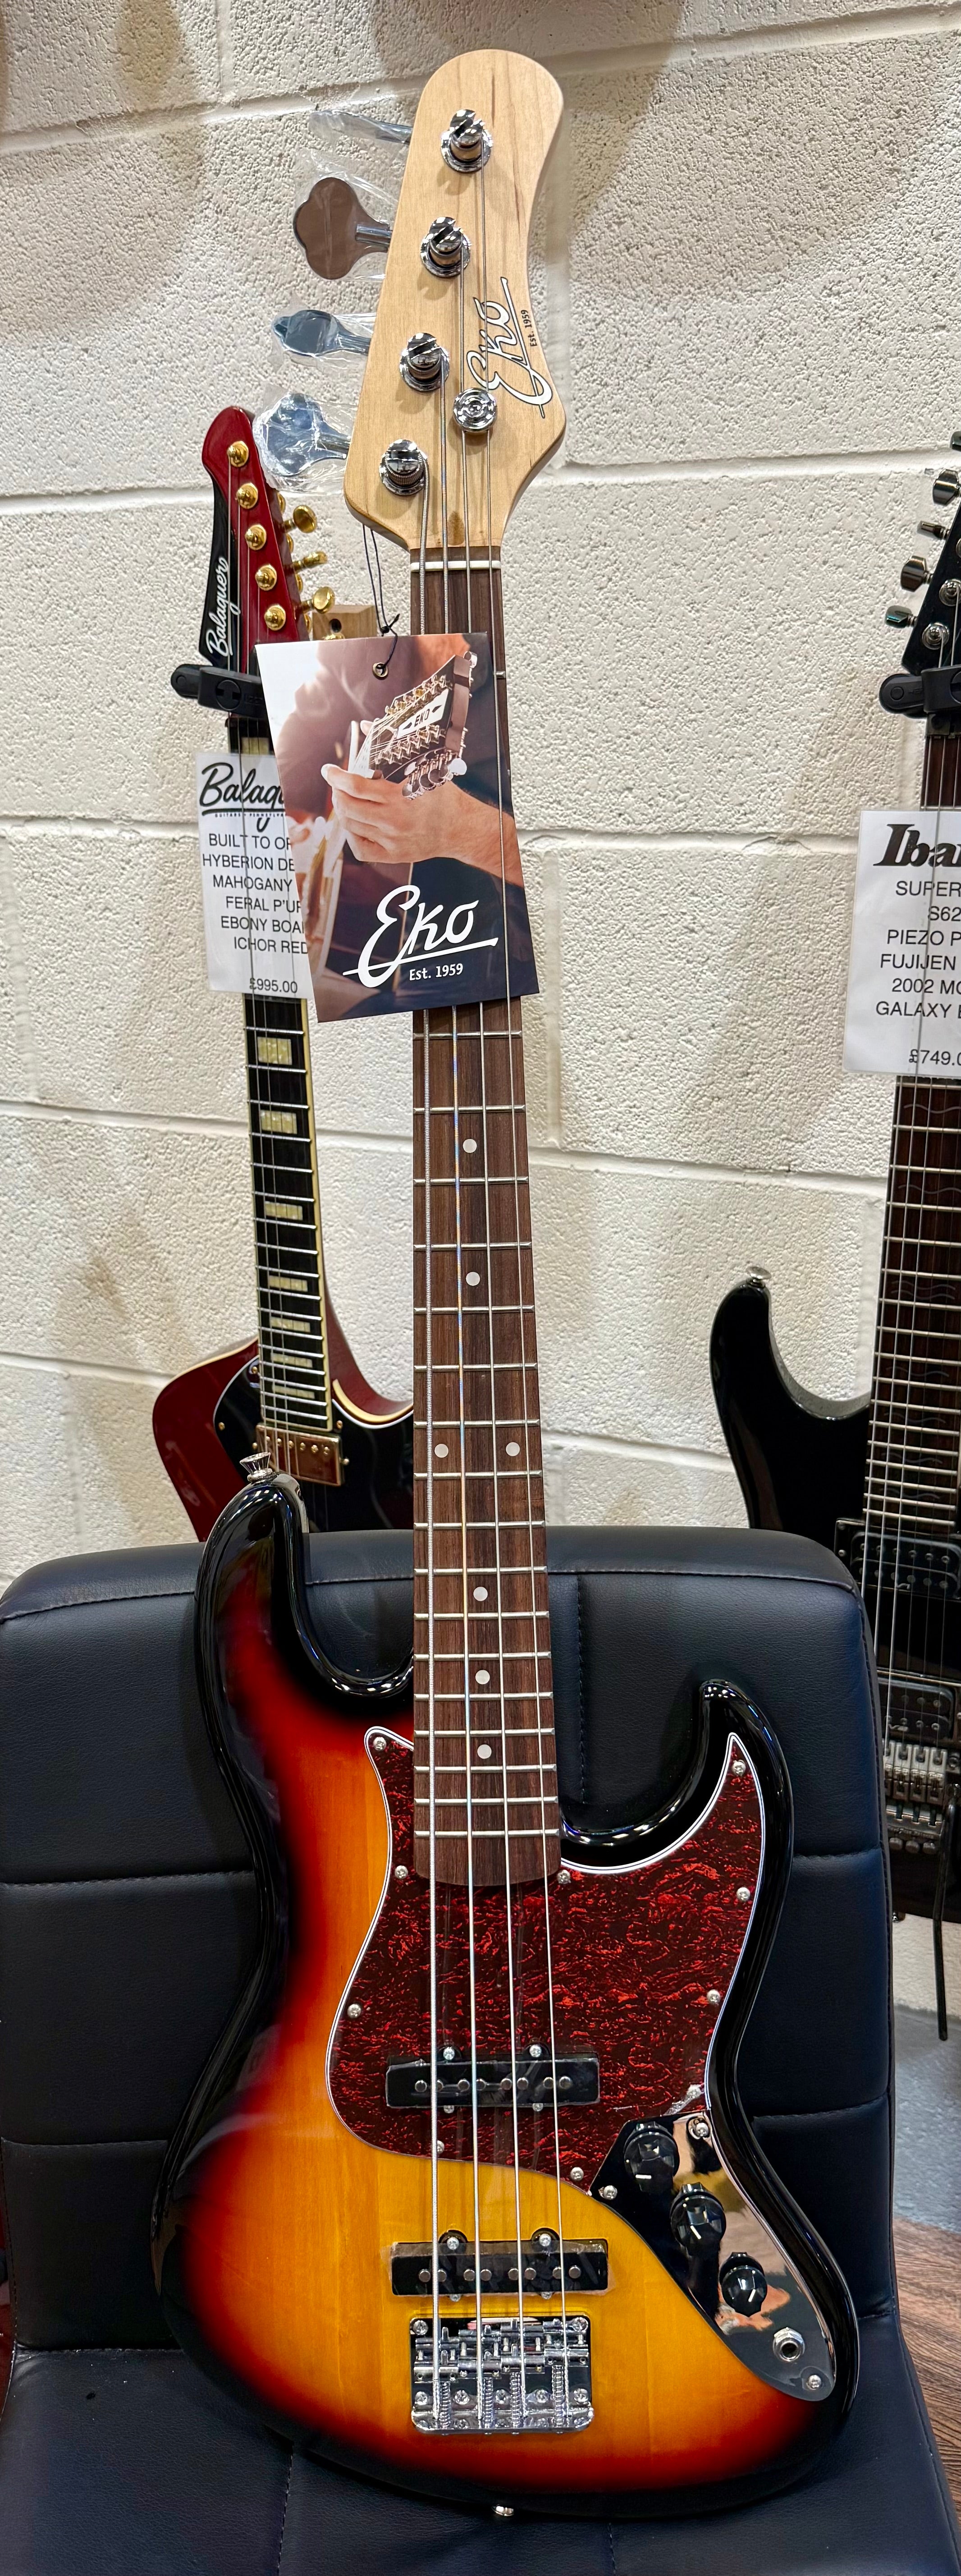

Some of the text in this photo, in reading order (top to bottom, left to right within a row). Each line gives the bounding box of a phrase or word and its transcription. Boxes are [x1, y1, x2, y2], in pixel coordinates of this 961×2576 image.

[521, 309, 538, 347] Est. 1959
[466, 295, 553, 406] Eko
[413, 708, 430, 727] EKO
[209, 833, 249, 848] BUILT
[252, 836, 270, 849] TO
[873, 824, 961, 867] Iba
[202, 854, 273, 870] HYBERION
[213, 874, 293, 892] MAHOGANY
[895, 881, 961, 897] SUPER
[226, 896, 270, 911] FERAL
[927, 906, 961, 921] S62
[221, 916, 305, 934] EBONY BOA
[356, 884, 480, 988] Eko
[887, 929, 944, 946] PIEZO
[234, 937, 308, 954] ICHOR RED
[880, 954, 956, 971] FUJIJEN
[409, 963, 464, 981] Est. 1959
[249, 978, 298, 994] £995.00
[892, 978, 934, 994] 2002
[876, 1001, 952, 1018] GALAXY
